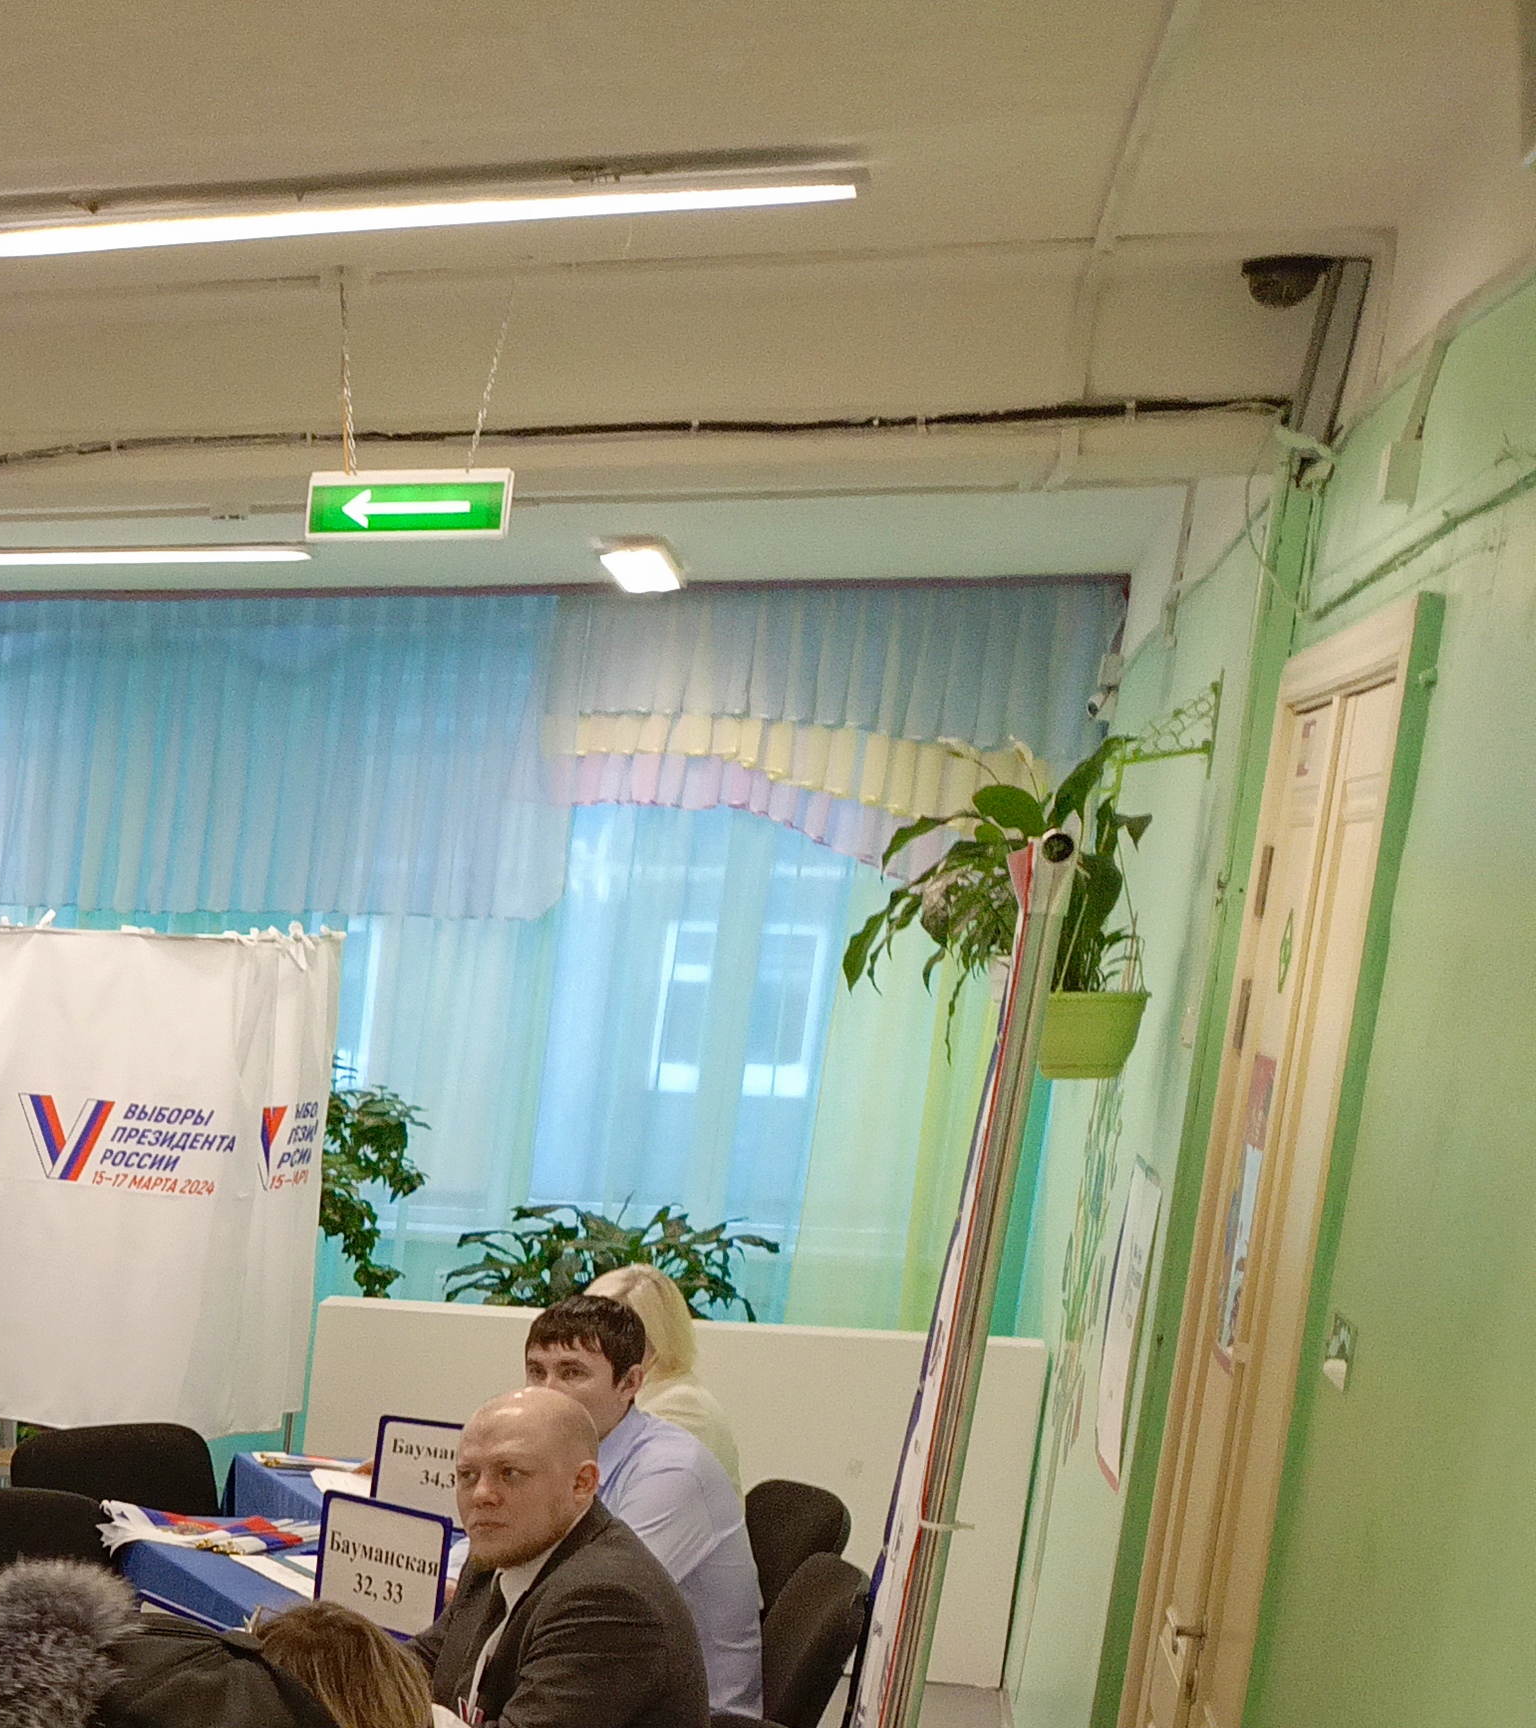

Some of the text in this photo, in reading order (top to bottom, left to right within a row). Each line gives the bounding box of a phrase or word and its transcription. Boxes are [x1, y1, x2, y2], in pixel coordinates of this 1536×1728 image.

[122, 1102, 216, 1127] ВЫБОРЫ
[110, 1126, 237, 1154] ПРЕЗИДЕНТА
[99, 1148, 181, 1173] РОССИИ
[128, 1173, 179, 1194] МАРТА
[178, 1179, 216, 1196] 2024
[391, 1437, 455, 1461] Баума
[330, 1529, 439, 1577] Бауманская
[353, 1572, 404, 1604] 32, 33
